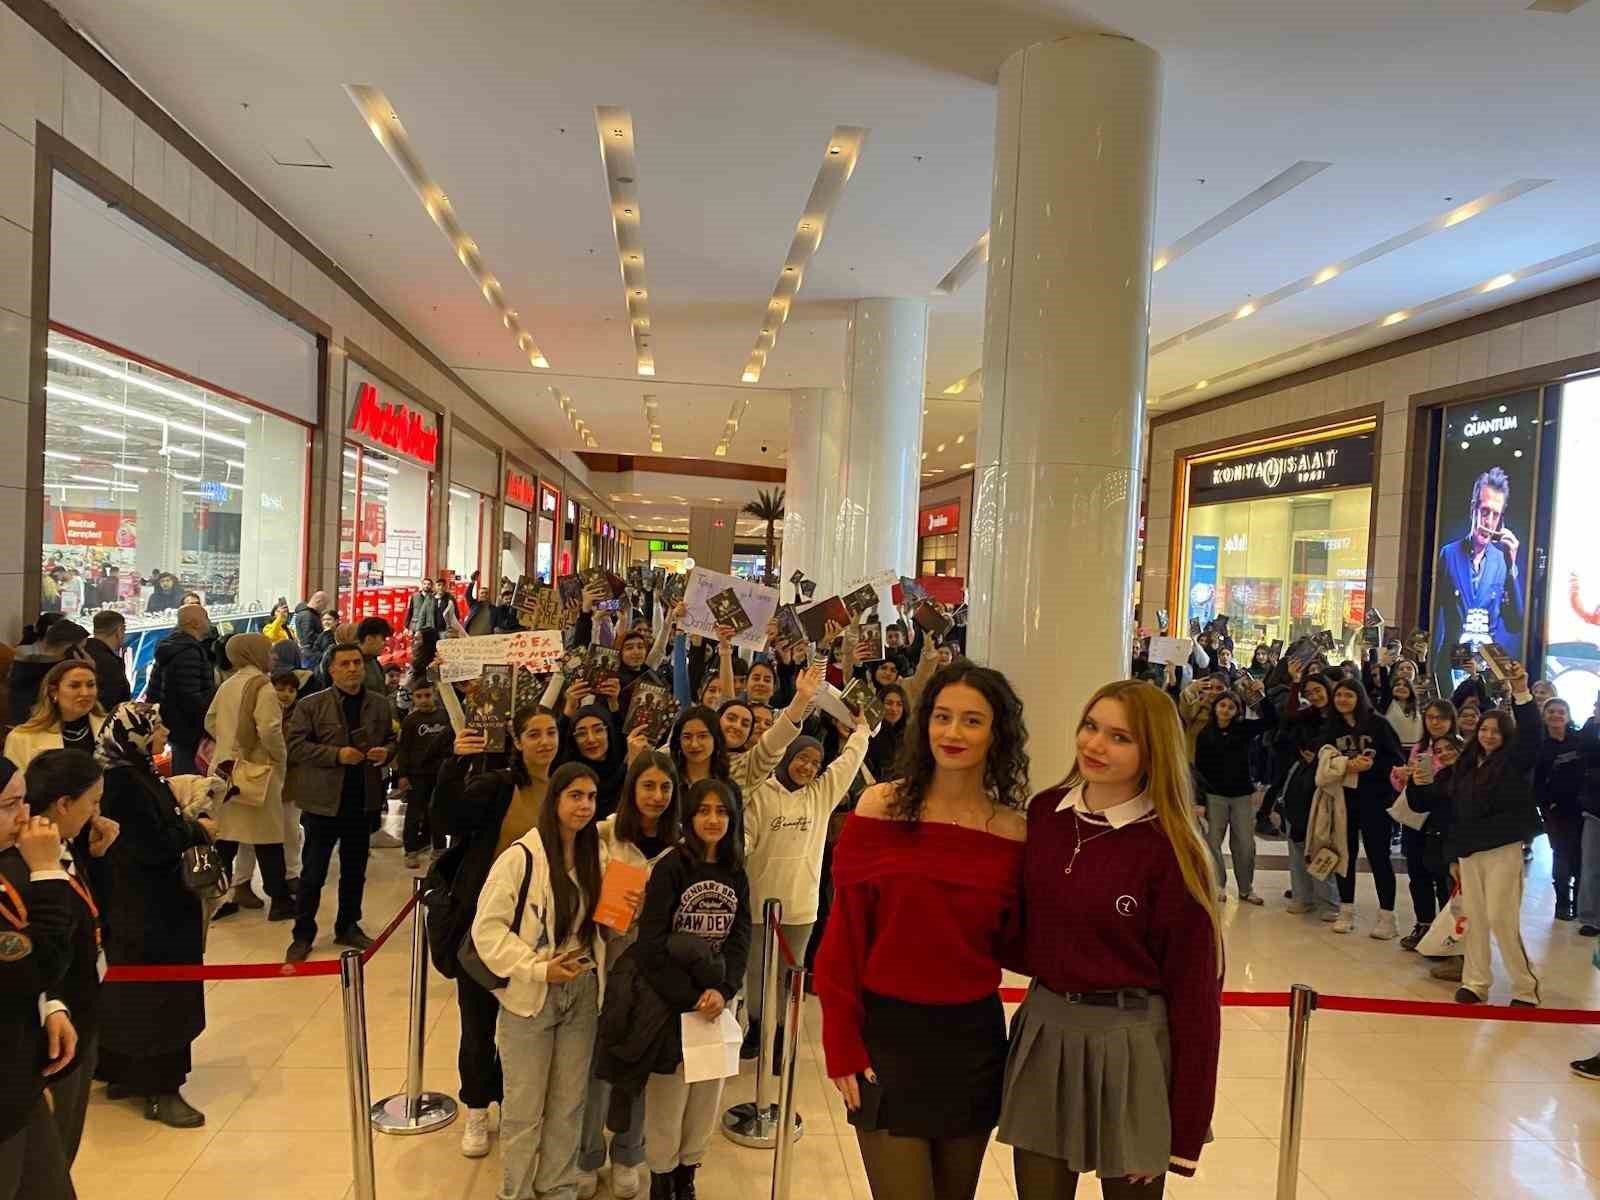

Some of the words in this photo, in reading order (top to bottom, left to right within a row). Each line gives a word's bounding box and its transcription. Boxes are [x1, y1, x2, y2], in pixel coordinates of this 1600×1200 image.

[1463, 415, 1518, 437] QUANTUM
[67, 519, 97, 529] Mutfak
[509, 639, 527, 649] NO
